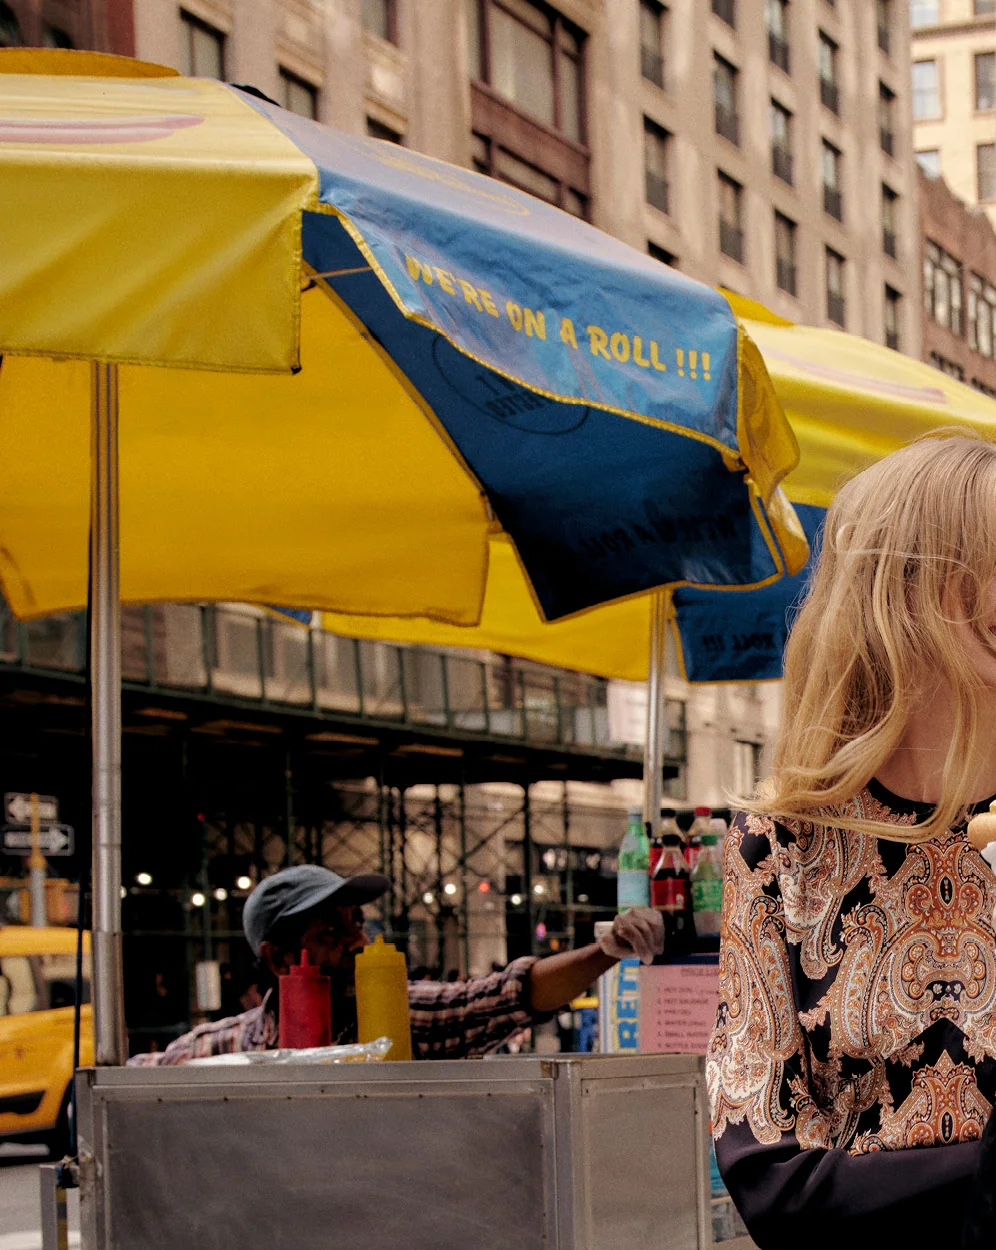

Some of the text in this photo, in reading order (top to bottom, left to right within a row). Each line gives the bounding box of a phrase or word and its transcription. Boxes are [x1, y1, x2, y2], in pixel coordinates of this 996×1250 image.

[404, 252, 711, 381] WE'RE ON A ROLL !!!
